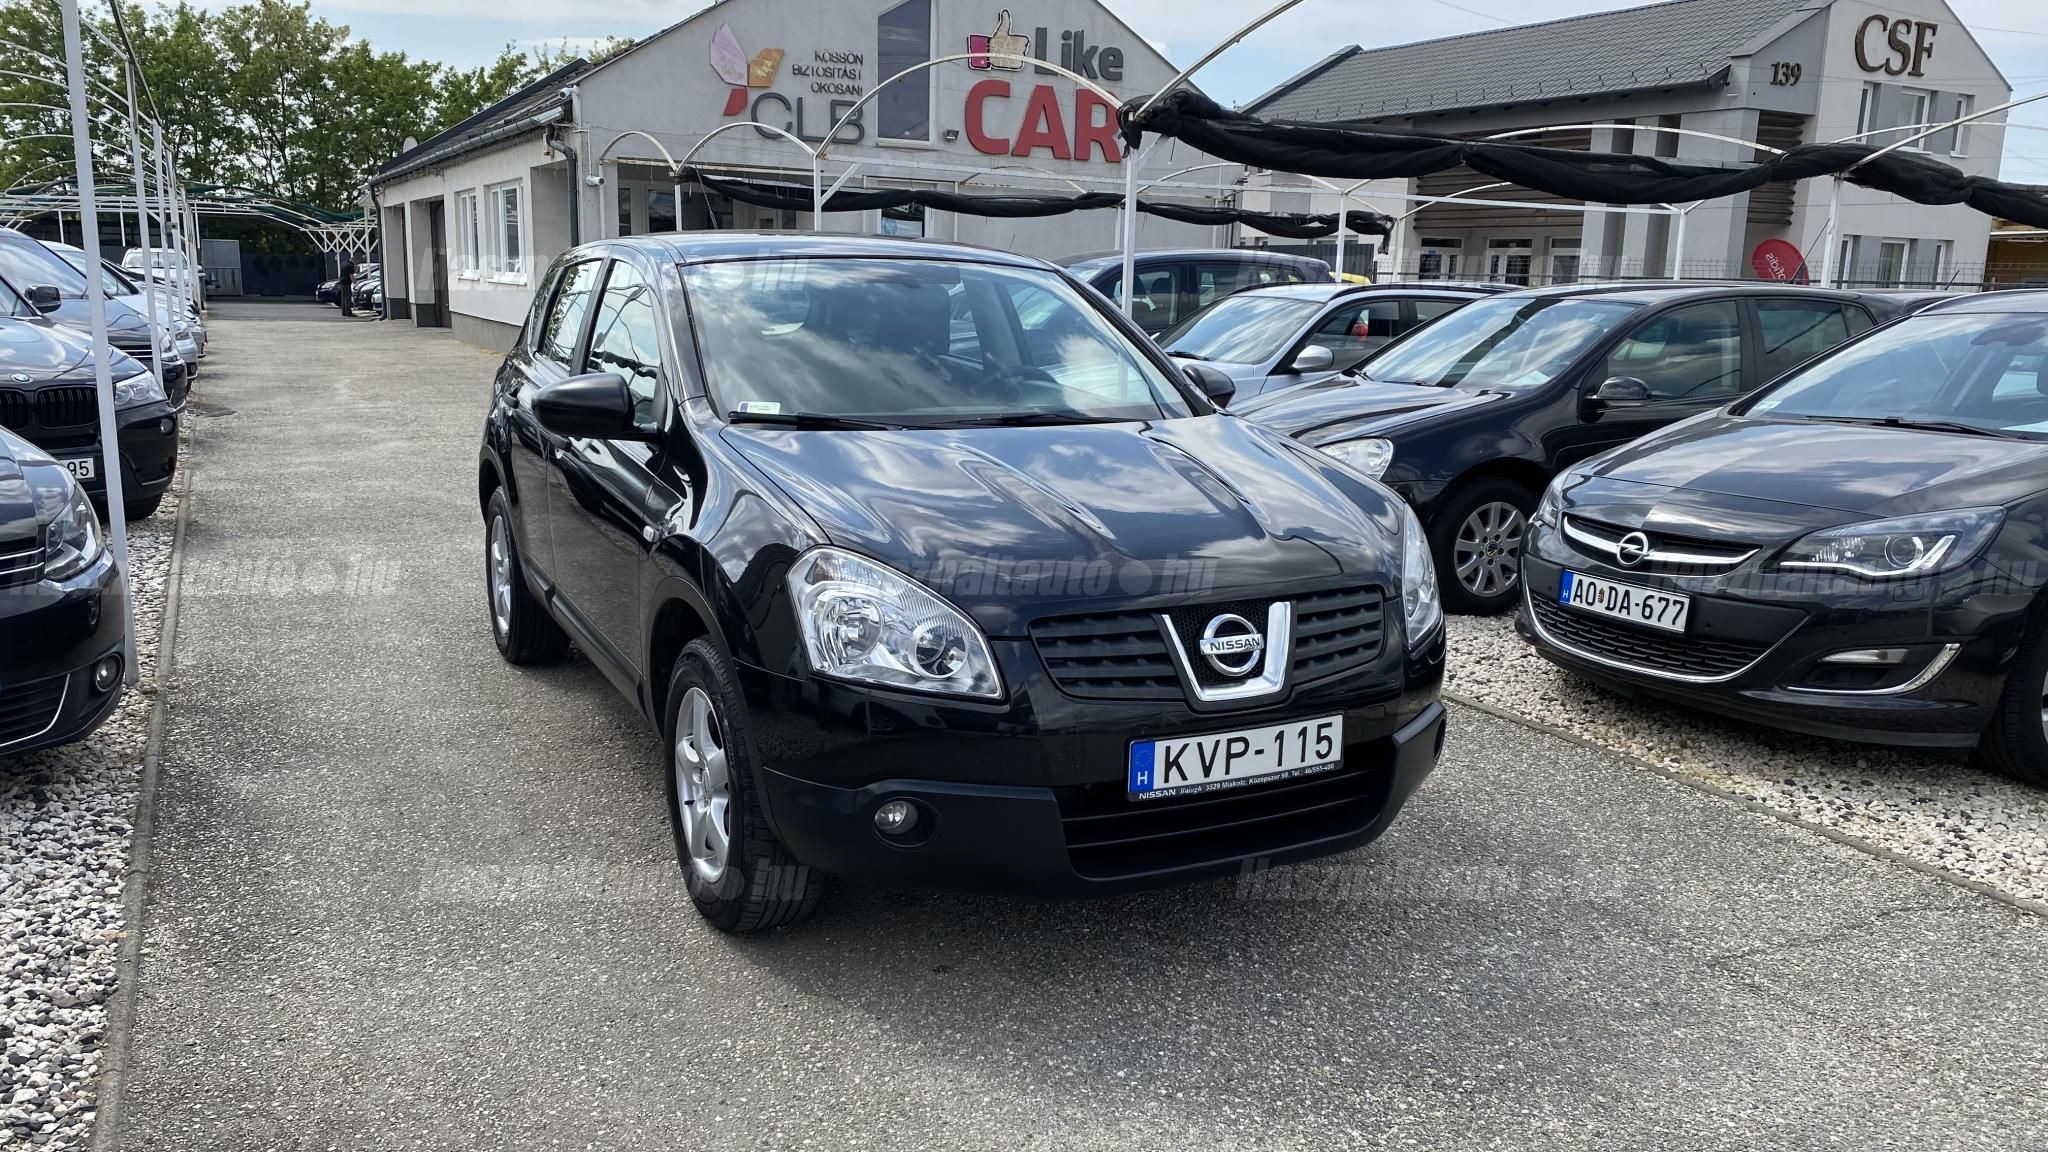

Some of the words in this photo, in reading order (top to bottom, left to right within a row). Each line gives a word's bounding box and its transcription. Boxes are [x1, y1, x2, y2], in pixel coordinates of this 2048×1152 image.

[1034, 27, 1124, 81] Like
[1855, 14, 1938, 77] CSF
[1770, 61, 1802, 86] 139
[751, 92, 865, 144] CLB
[965, 79, 1122, 163] CAR
[1562, 589, 1569, 599] H
[1573, 579, 1597, 606] AO
[1605, 586, 1685, 625] DA-677
[1210, 638, 1260, 651] NISSAN
[1164, 722, 1333, 783] KVP-115
[1137, 771, 1148, 785] H
[1139, 789, 1176, 799] NISSAN
